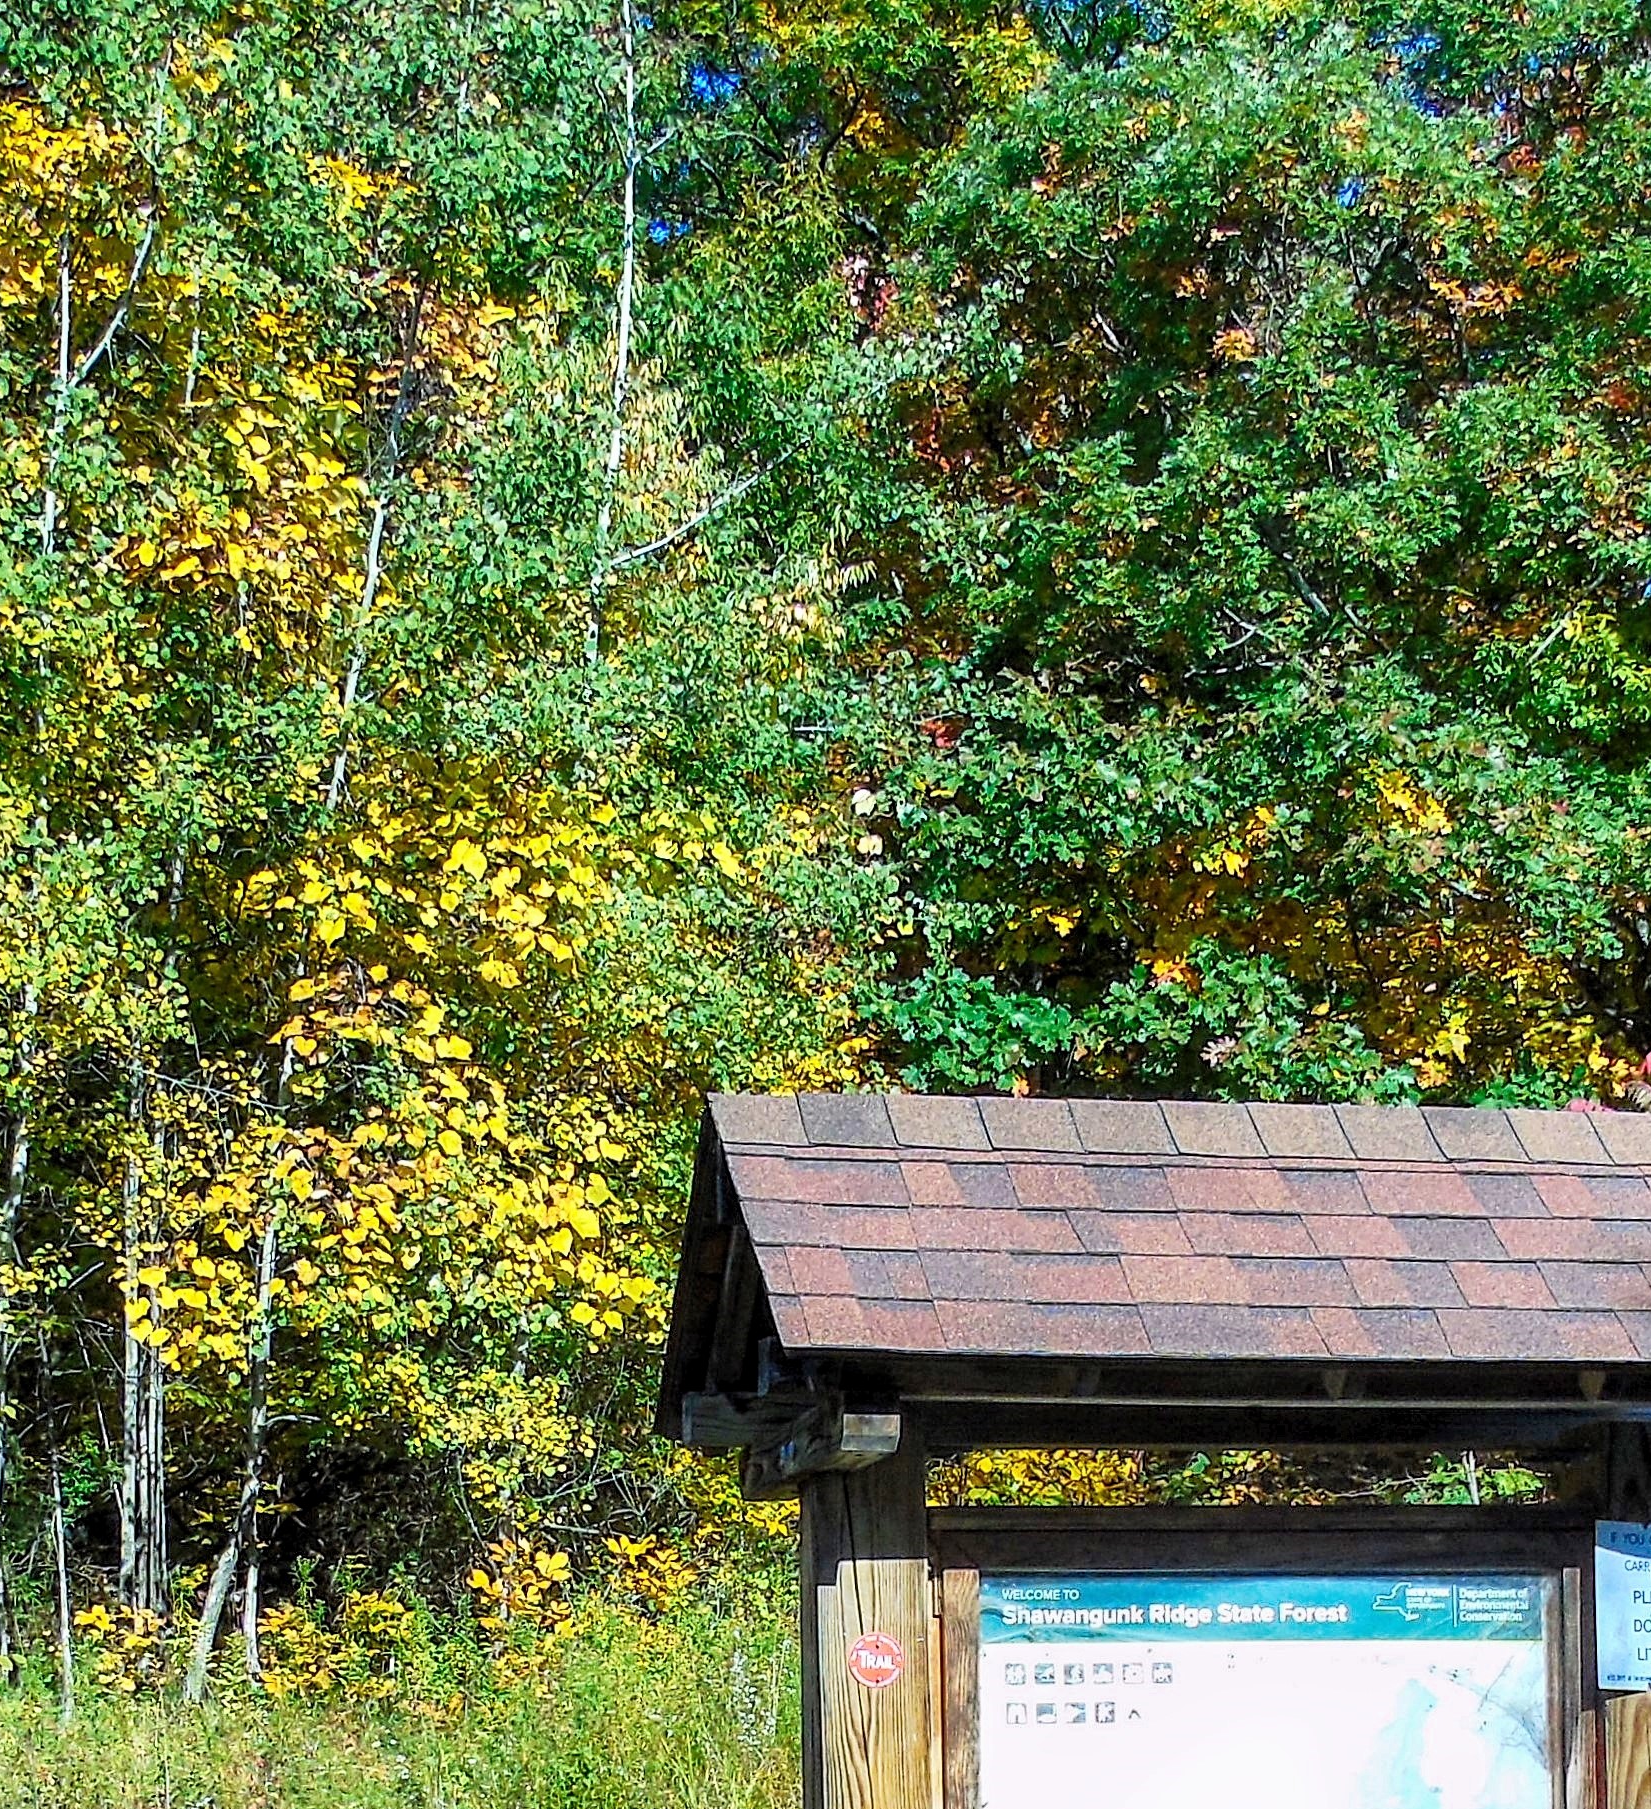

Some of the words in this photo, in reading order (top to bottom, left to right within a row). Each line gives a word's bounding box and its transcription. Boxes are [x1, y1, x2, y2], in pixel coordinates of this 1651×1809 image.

[1610, 1531, 1617, 1544] IF
[1624, 1532, 1645, 1545] YOU
[1001, 1589, 1061, 1600] WELCOME
[1063, 1589, 1080, 1600] TO
[1459, 1587, 1518, 1601] Department
[1519, 1587, 1529, 1598] of
[1459, 1600, 1529, 1611] Environmental
[1002, 1604, 1145, 1629] Shawangunk
[1149, 1603, 1213, 1629] Ridge
[1216, 1602, 1275, 1624] State
[1279, 1602, 1349, 1623] Forest
[1459, 1611, 1523, 1623] Conservation
[857, 1649, 896, 1670] TRAIL
